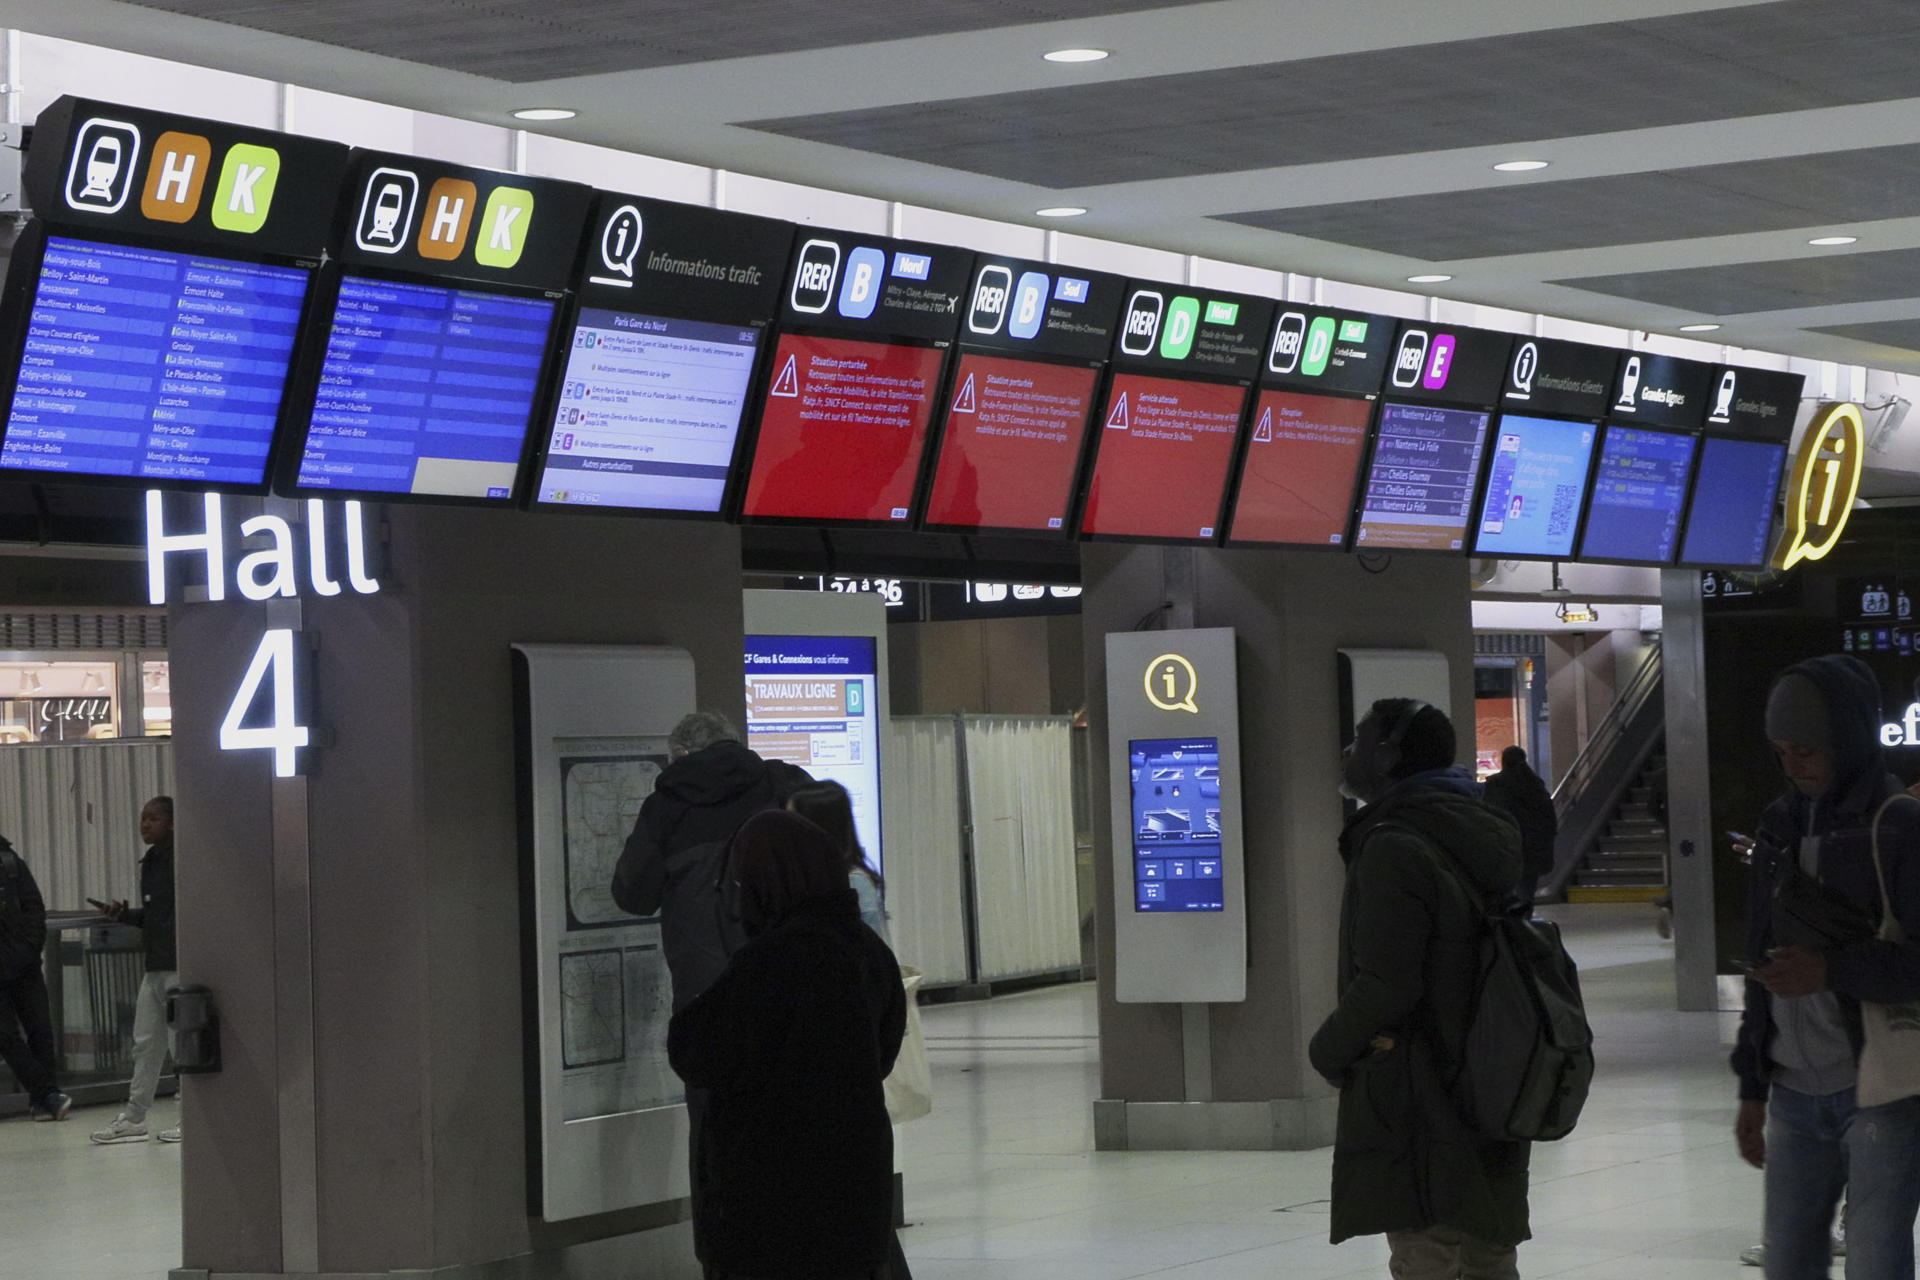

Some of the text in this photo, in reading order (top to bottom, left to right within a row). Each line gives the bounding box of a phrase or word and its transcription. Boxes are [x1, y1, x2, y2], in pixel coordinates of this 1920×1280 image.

[156, 151, 267, 214] H K
[431, 196, 522, 251] H K
[648, 251, 761, 284] Informations trafic
[900, 257, 924, 274] Nord
[68, 272, 109, 284] Saint-Martin
[800, 262, 872, 302] RER B
[1064, 282, 1080, 297] Sud
[976, 286, 1039, 324] RER B
[1211, 305, 1232, 320] Nord
[614, 316, 667, 331] Paris Gare du Nord
[1128, 310, 1190, 344] RER D
[1276, 330, 1327, 362] RER D
[810, 355, 868, 371] Situation perturbée
[1400, 346, 1448, 378] RER E
[1537, 374, 1604, 394] Informations clients
[1642, 386, 1684, 407] Grandes lignes
[10, 412, 38, 422] Domont
[1401, 409, 1445, 422] Nanterre La Folie
[1394, 439, 1439, 451] Nanterre La Folie
[1388, 469, 1431, 483] Chelles Gournay
[1384, 484, 1428, 498] Chelles Gournay
[1382, 500, 1427, 511] Nanterre La Folie
[146, 490, 380, 604] Hall
[862, 579, 869, 591] à
[874, 579, 902, 601] 36
[753, 655, 771, 664] Gares
[773, 655, 777, 664] &
[779, 655, 813, 664] Connexions
[828, 655, 849, 664] informe
[220, 629, 308, 777] 4
[754, 684, 859, 706] TRAVAUX LIGNE D
